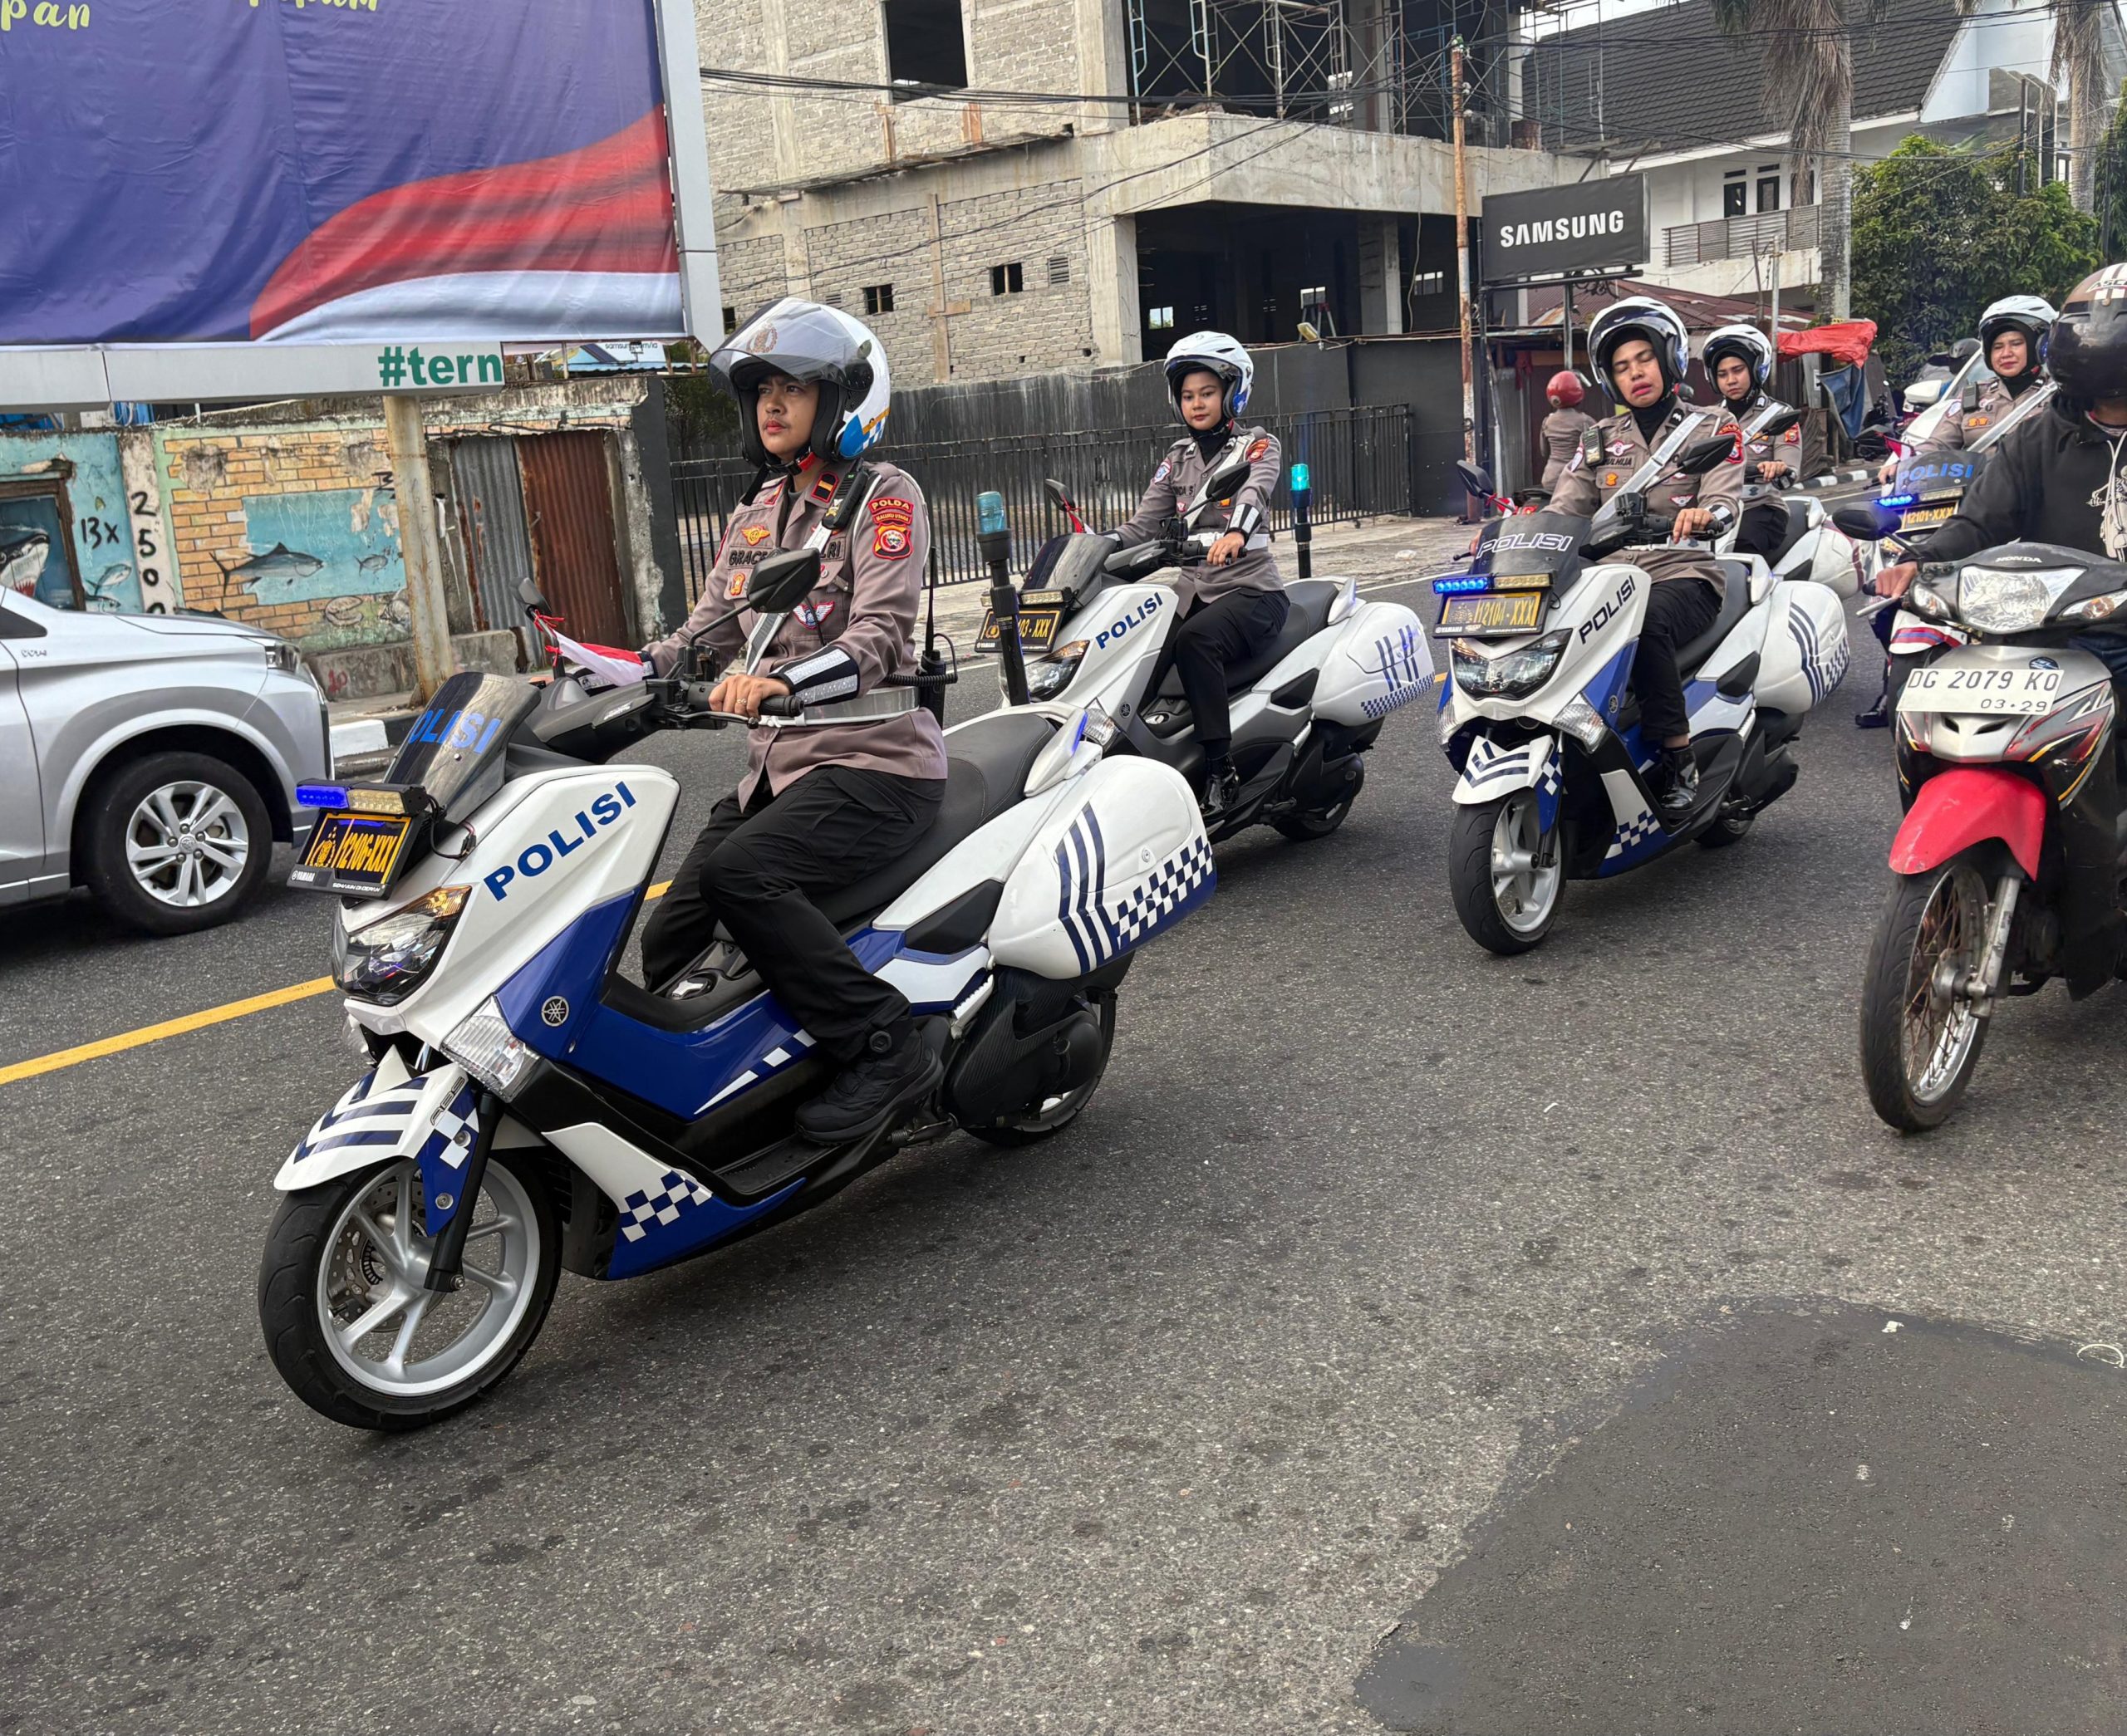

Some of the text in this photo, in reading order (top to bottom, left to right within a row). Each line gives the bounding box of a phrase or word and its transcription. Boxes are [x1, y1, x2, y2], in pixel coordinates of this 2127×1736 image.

[1500, 210, 1624, 248] SAMSUNG
[377, 346, 503, 387] #tern
[1899, 463, 1974, 482] POLISI
[872, 499, 910, 510] POLDA
[1476, 532, 1574, 560] POLISI
[1095, 591, 1163, 650] POLISI
[1579, 575, 1636, 645] POLISI
[1908, 670, 1939, 689] DG
[1948, 670, 2014, 689] 2079
[408, 709, 501, 754] OLISI
[484, 781, 636, 901] POLISI
